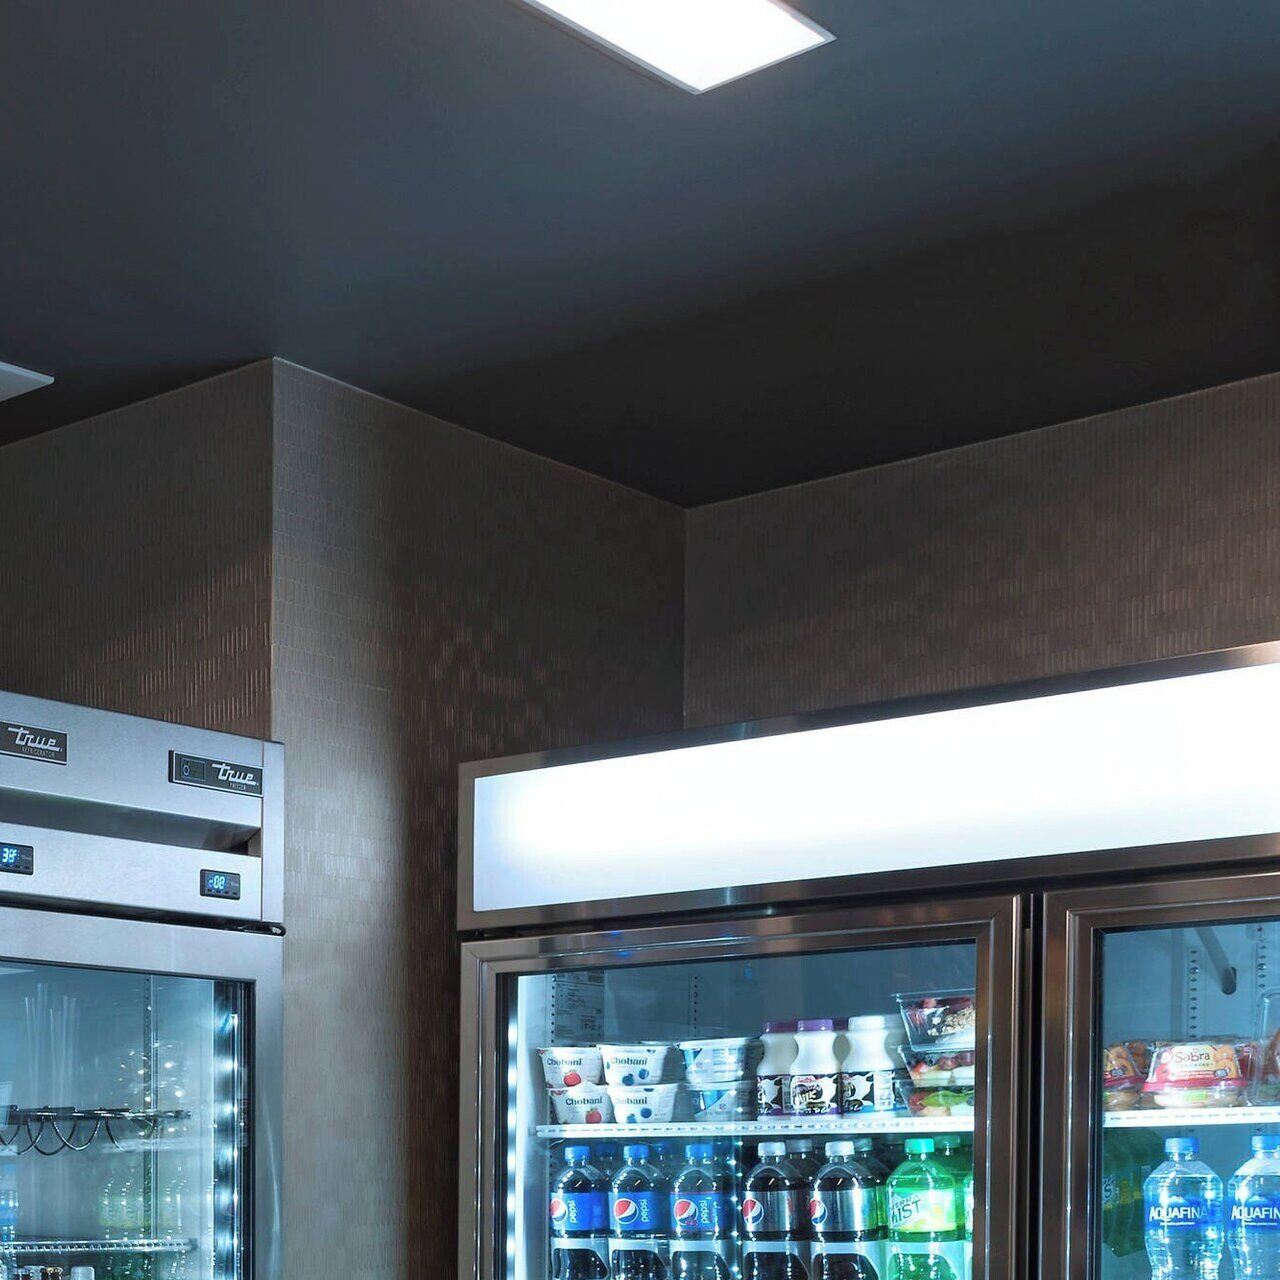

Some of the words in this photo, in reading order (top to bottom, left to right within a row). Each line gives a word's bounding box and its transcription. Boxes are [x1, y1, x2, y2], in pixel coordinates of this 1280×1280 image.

[546, 1057, 582, 1067] Chobani
[610, 1056, 648, 1066] Chobani
[1175, 1051, 1211, 1063] Sabra
[565, 1096, 602, 1106] Chobani
[567, 1200, 578, 1224] pepsi
[641, 1199, 649, 1223] pepsi
[700, 1200, 710, 1224] pepsi
[1149, 1206, 1208, 1221] AQUAFINA
[1231, 1206, 1280, 1221] AQUAFIN
